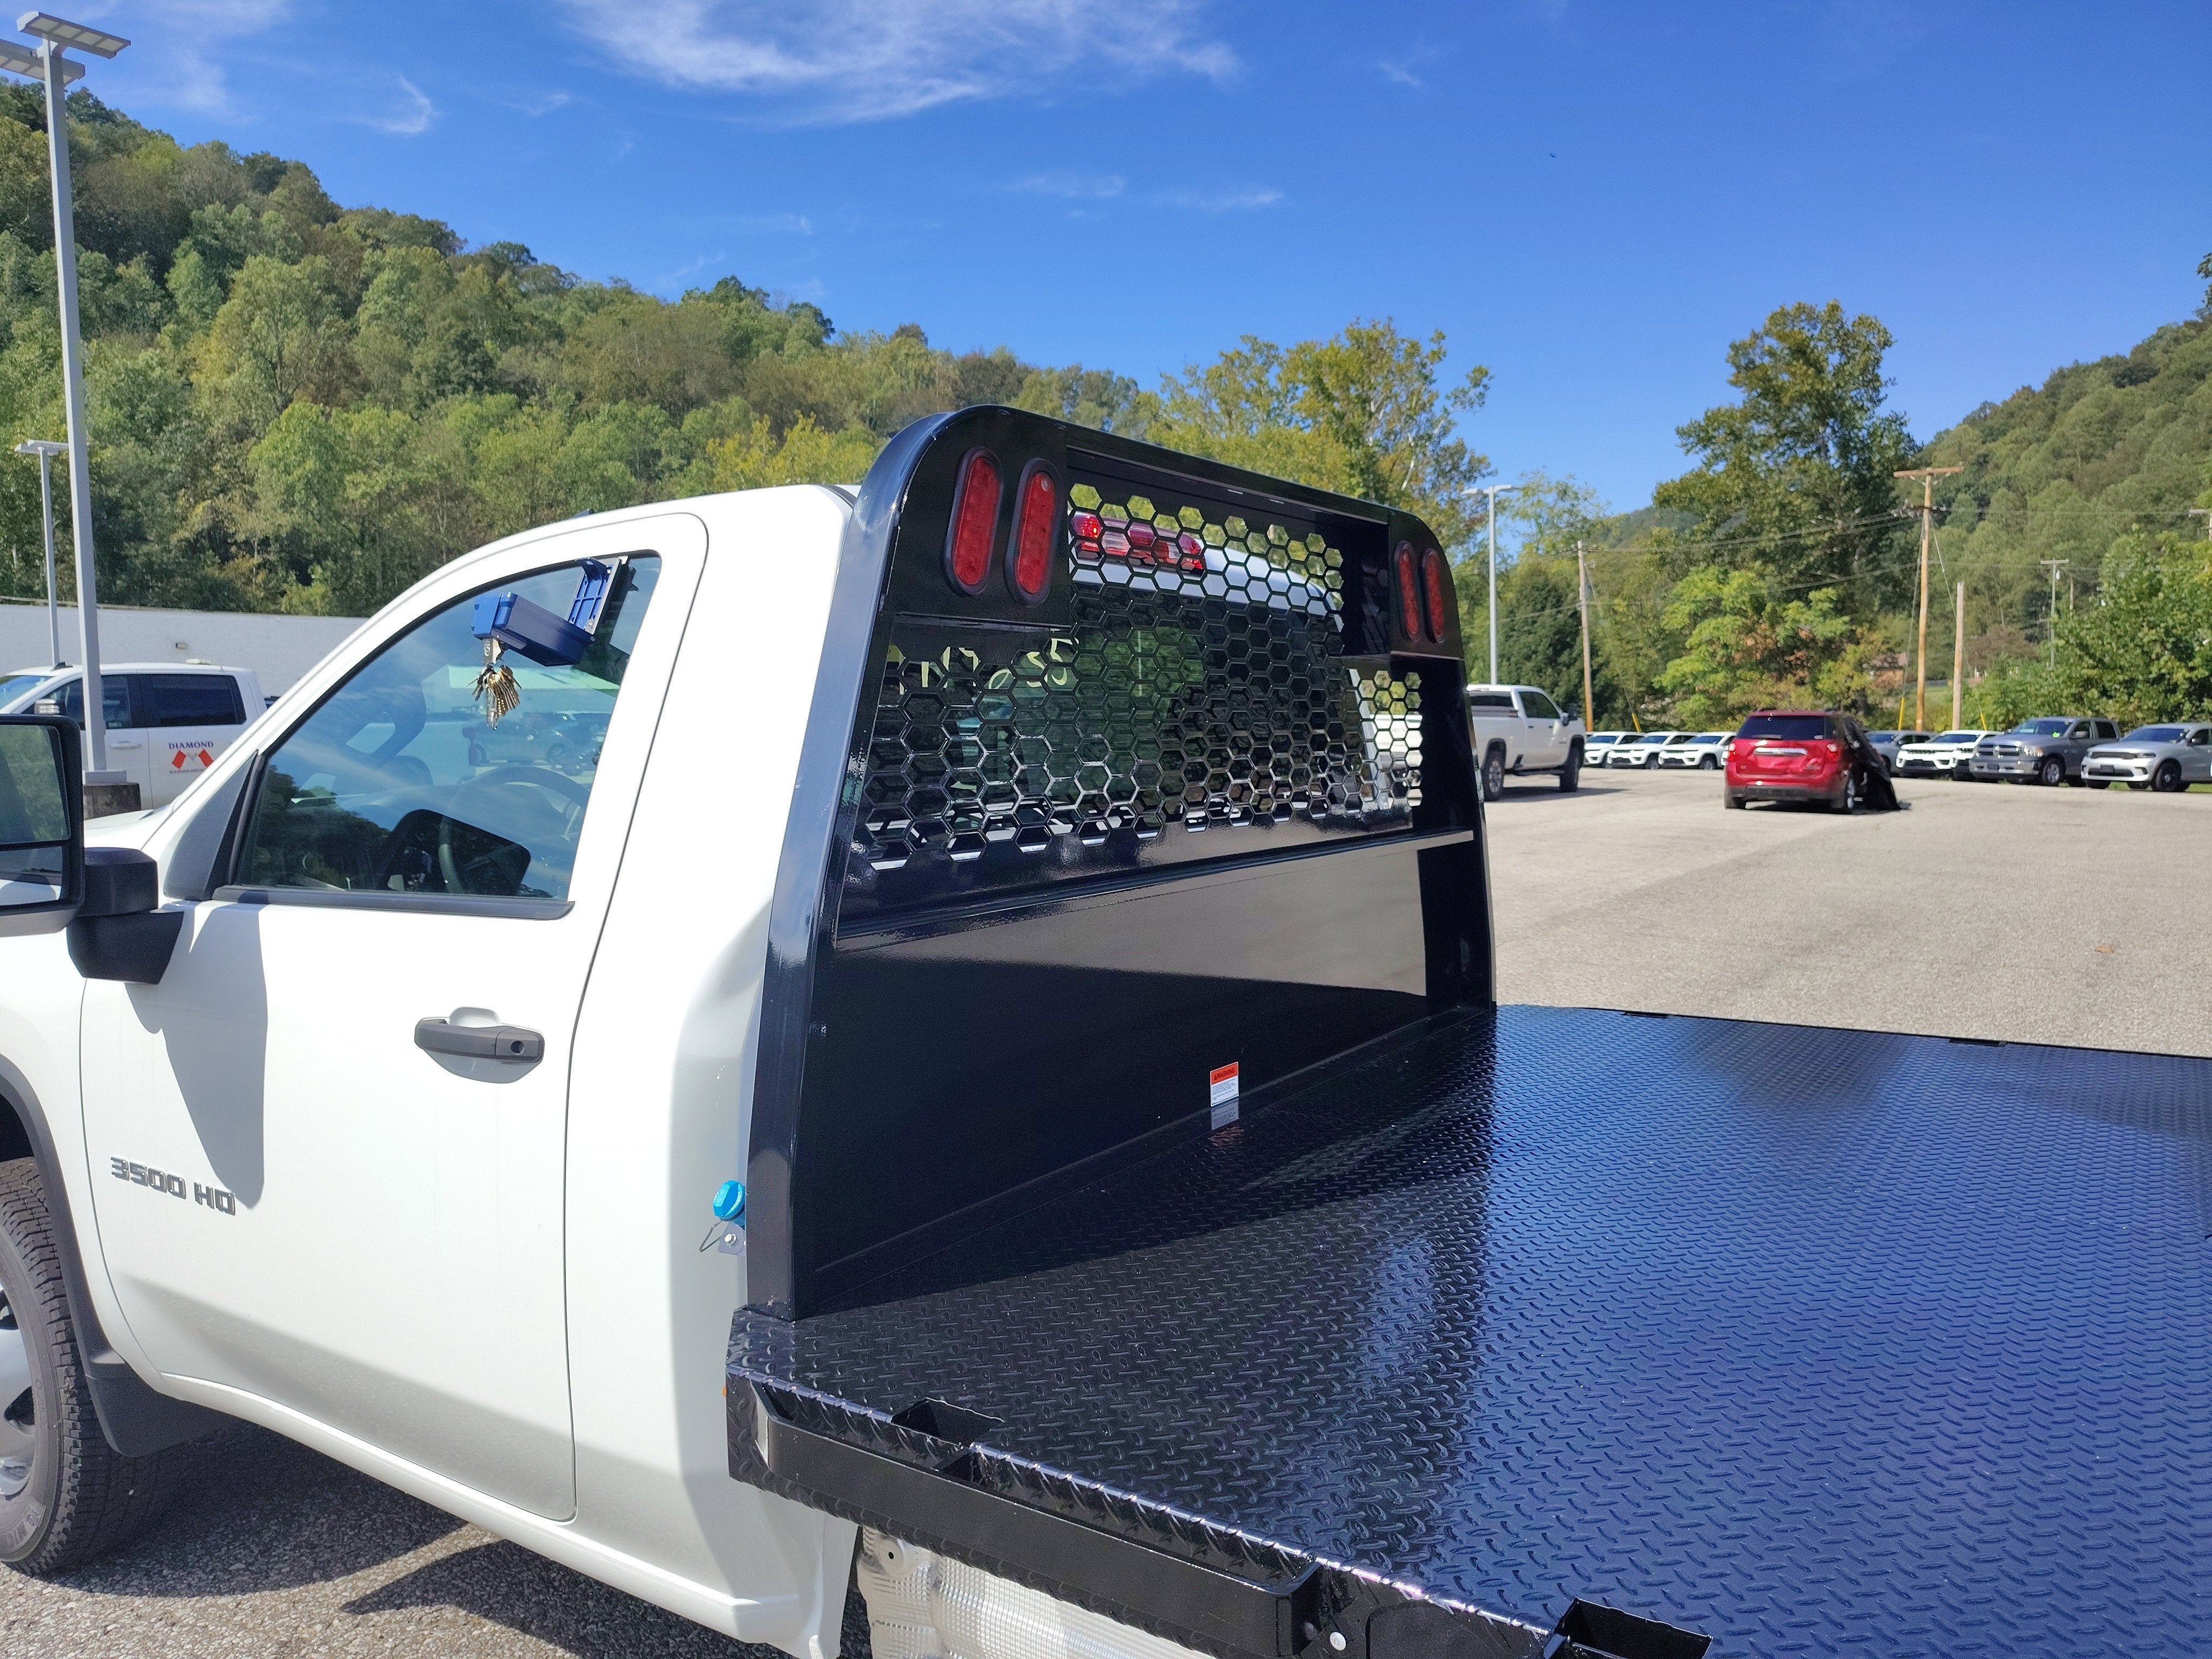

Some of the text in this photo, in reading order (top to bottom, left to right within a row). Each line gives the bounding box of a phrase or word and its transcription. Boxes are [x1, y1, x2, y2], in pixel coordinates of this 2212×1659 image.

[168, 741, 214, 750] DIAMOND
[1217, 1067, 1235, 1079] WARNING
[111, 1155, 236, 1216] 3500 HD
